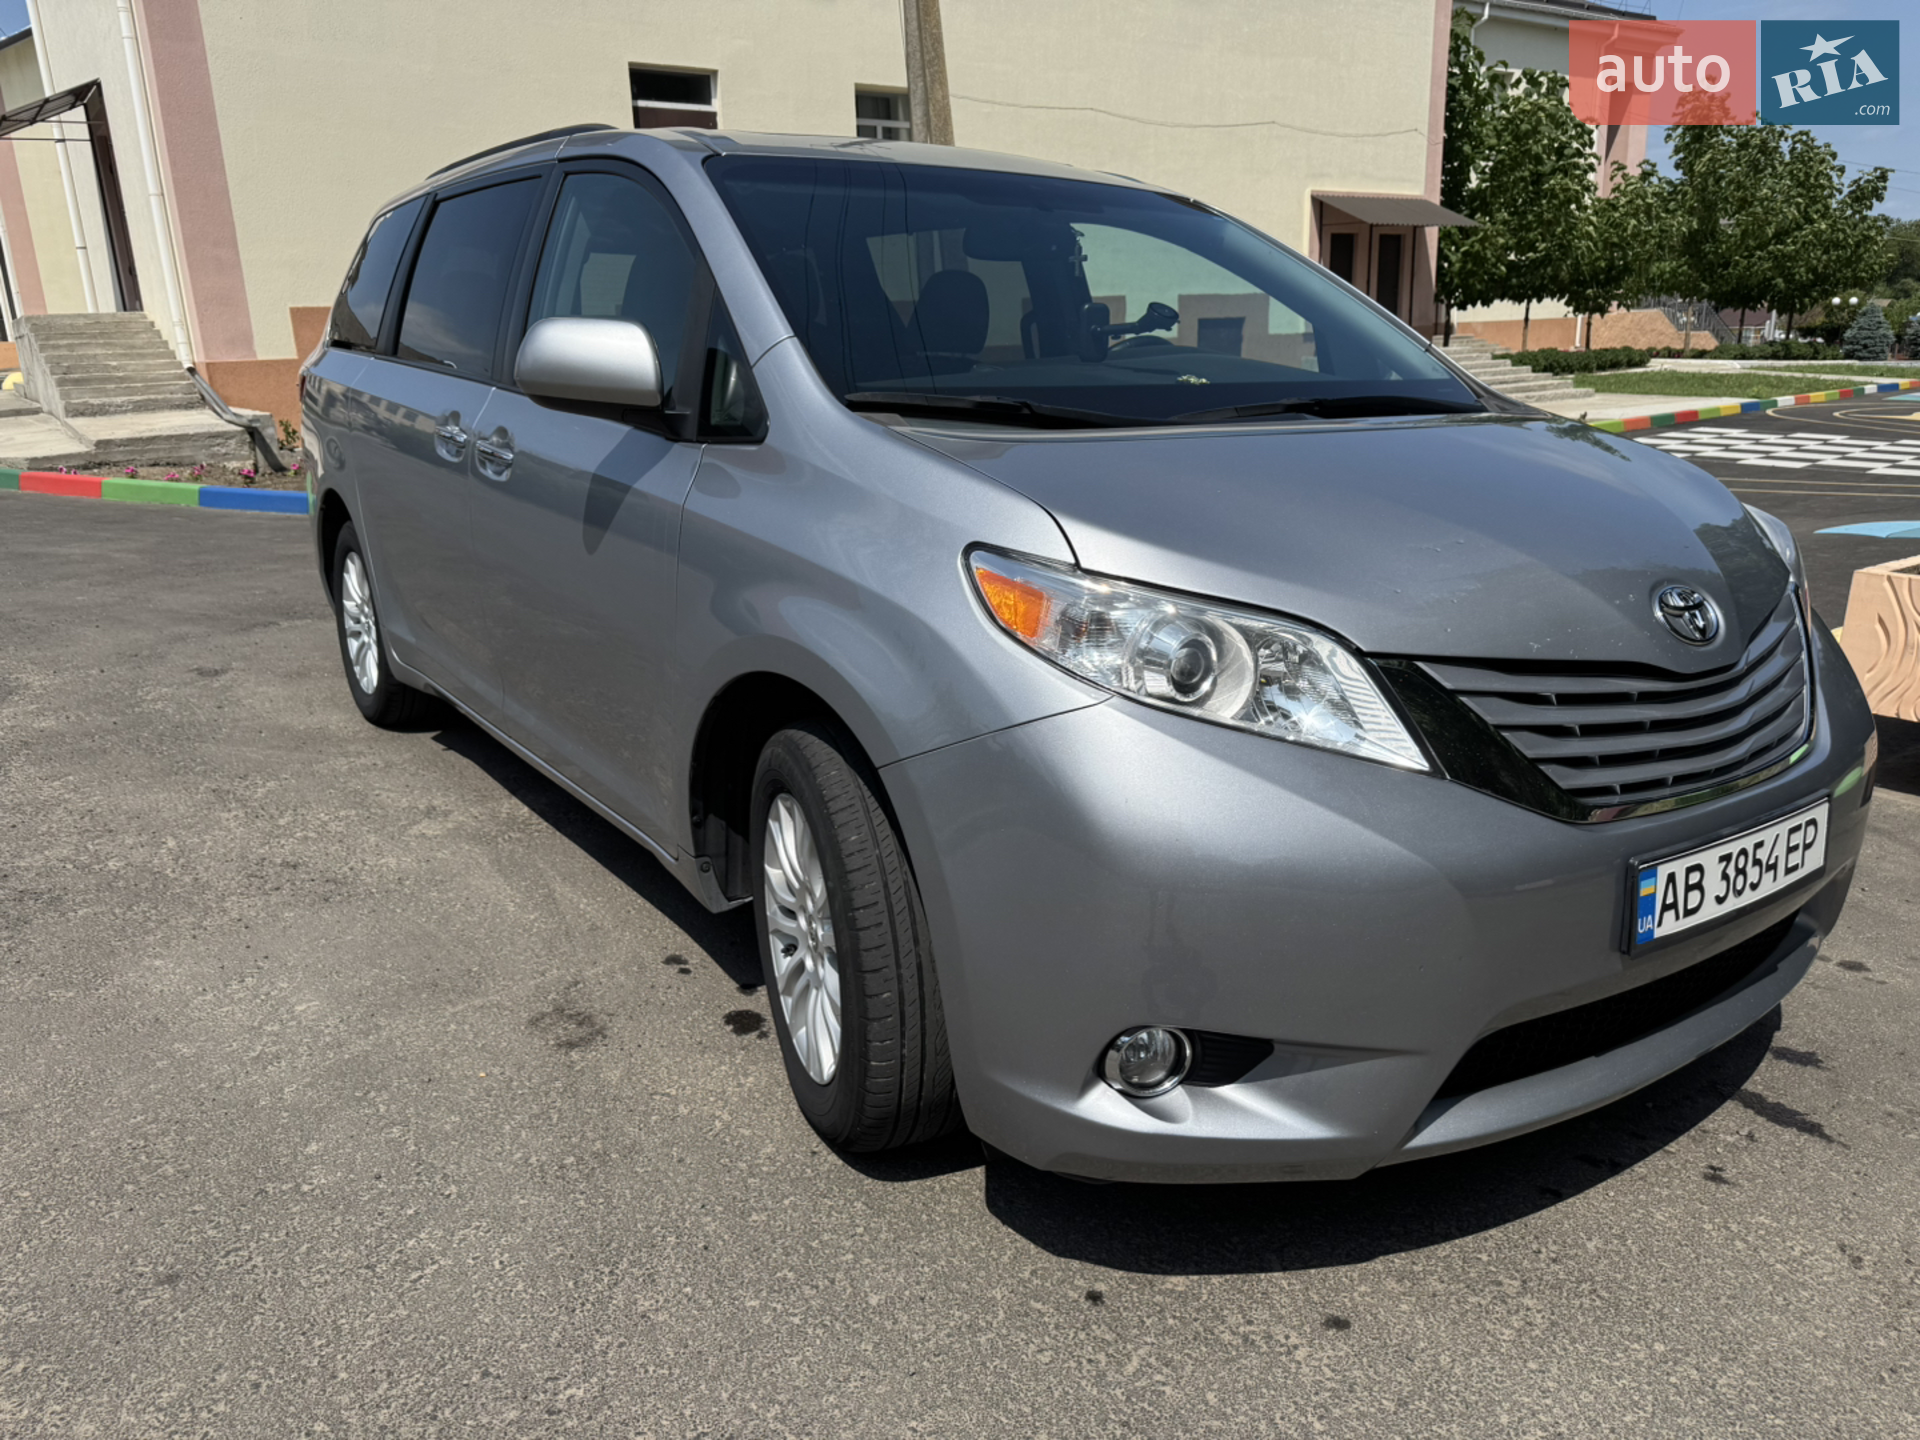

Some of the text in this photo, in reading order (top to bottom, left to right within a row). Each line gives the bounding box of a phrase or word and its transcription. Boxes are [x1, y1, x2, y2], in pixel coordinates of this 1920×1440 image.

[1657, 817, 1818, 928] AB 3854 EP
[1638, 915, 1653, 933] UA
